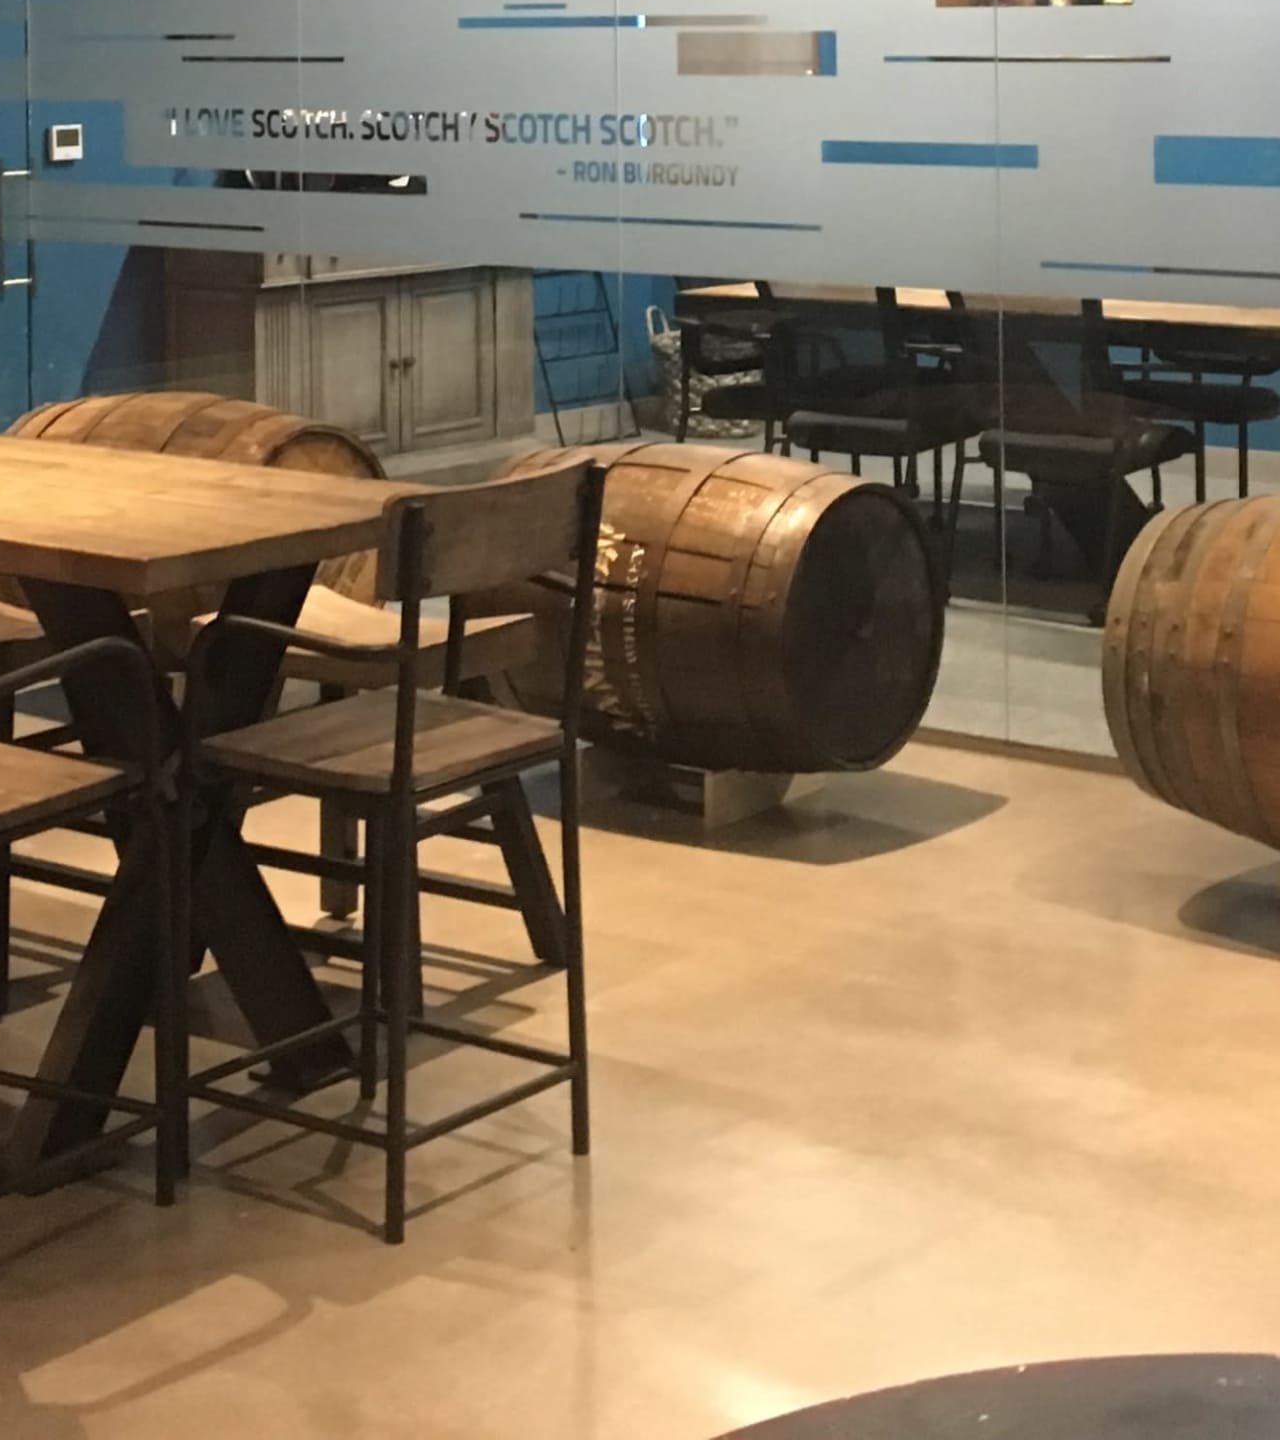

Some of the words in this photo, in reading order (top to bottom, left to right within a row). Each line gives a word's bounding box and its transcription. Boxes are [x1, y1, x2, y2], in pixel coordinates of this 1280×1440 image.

[184, 107, 245, 138] LOVE
[252, 108, 355, 139] SCOTCH.
[485, 112, 591, 145] SCOTCH
[573, 161, 617, 184] RON
[623, 162, 739, 187] BURGUNDY
